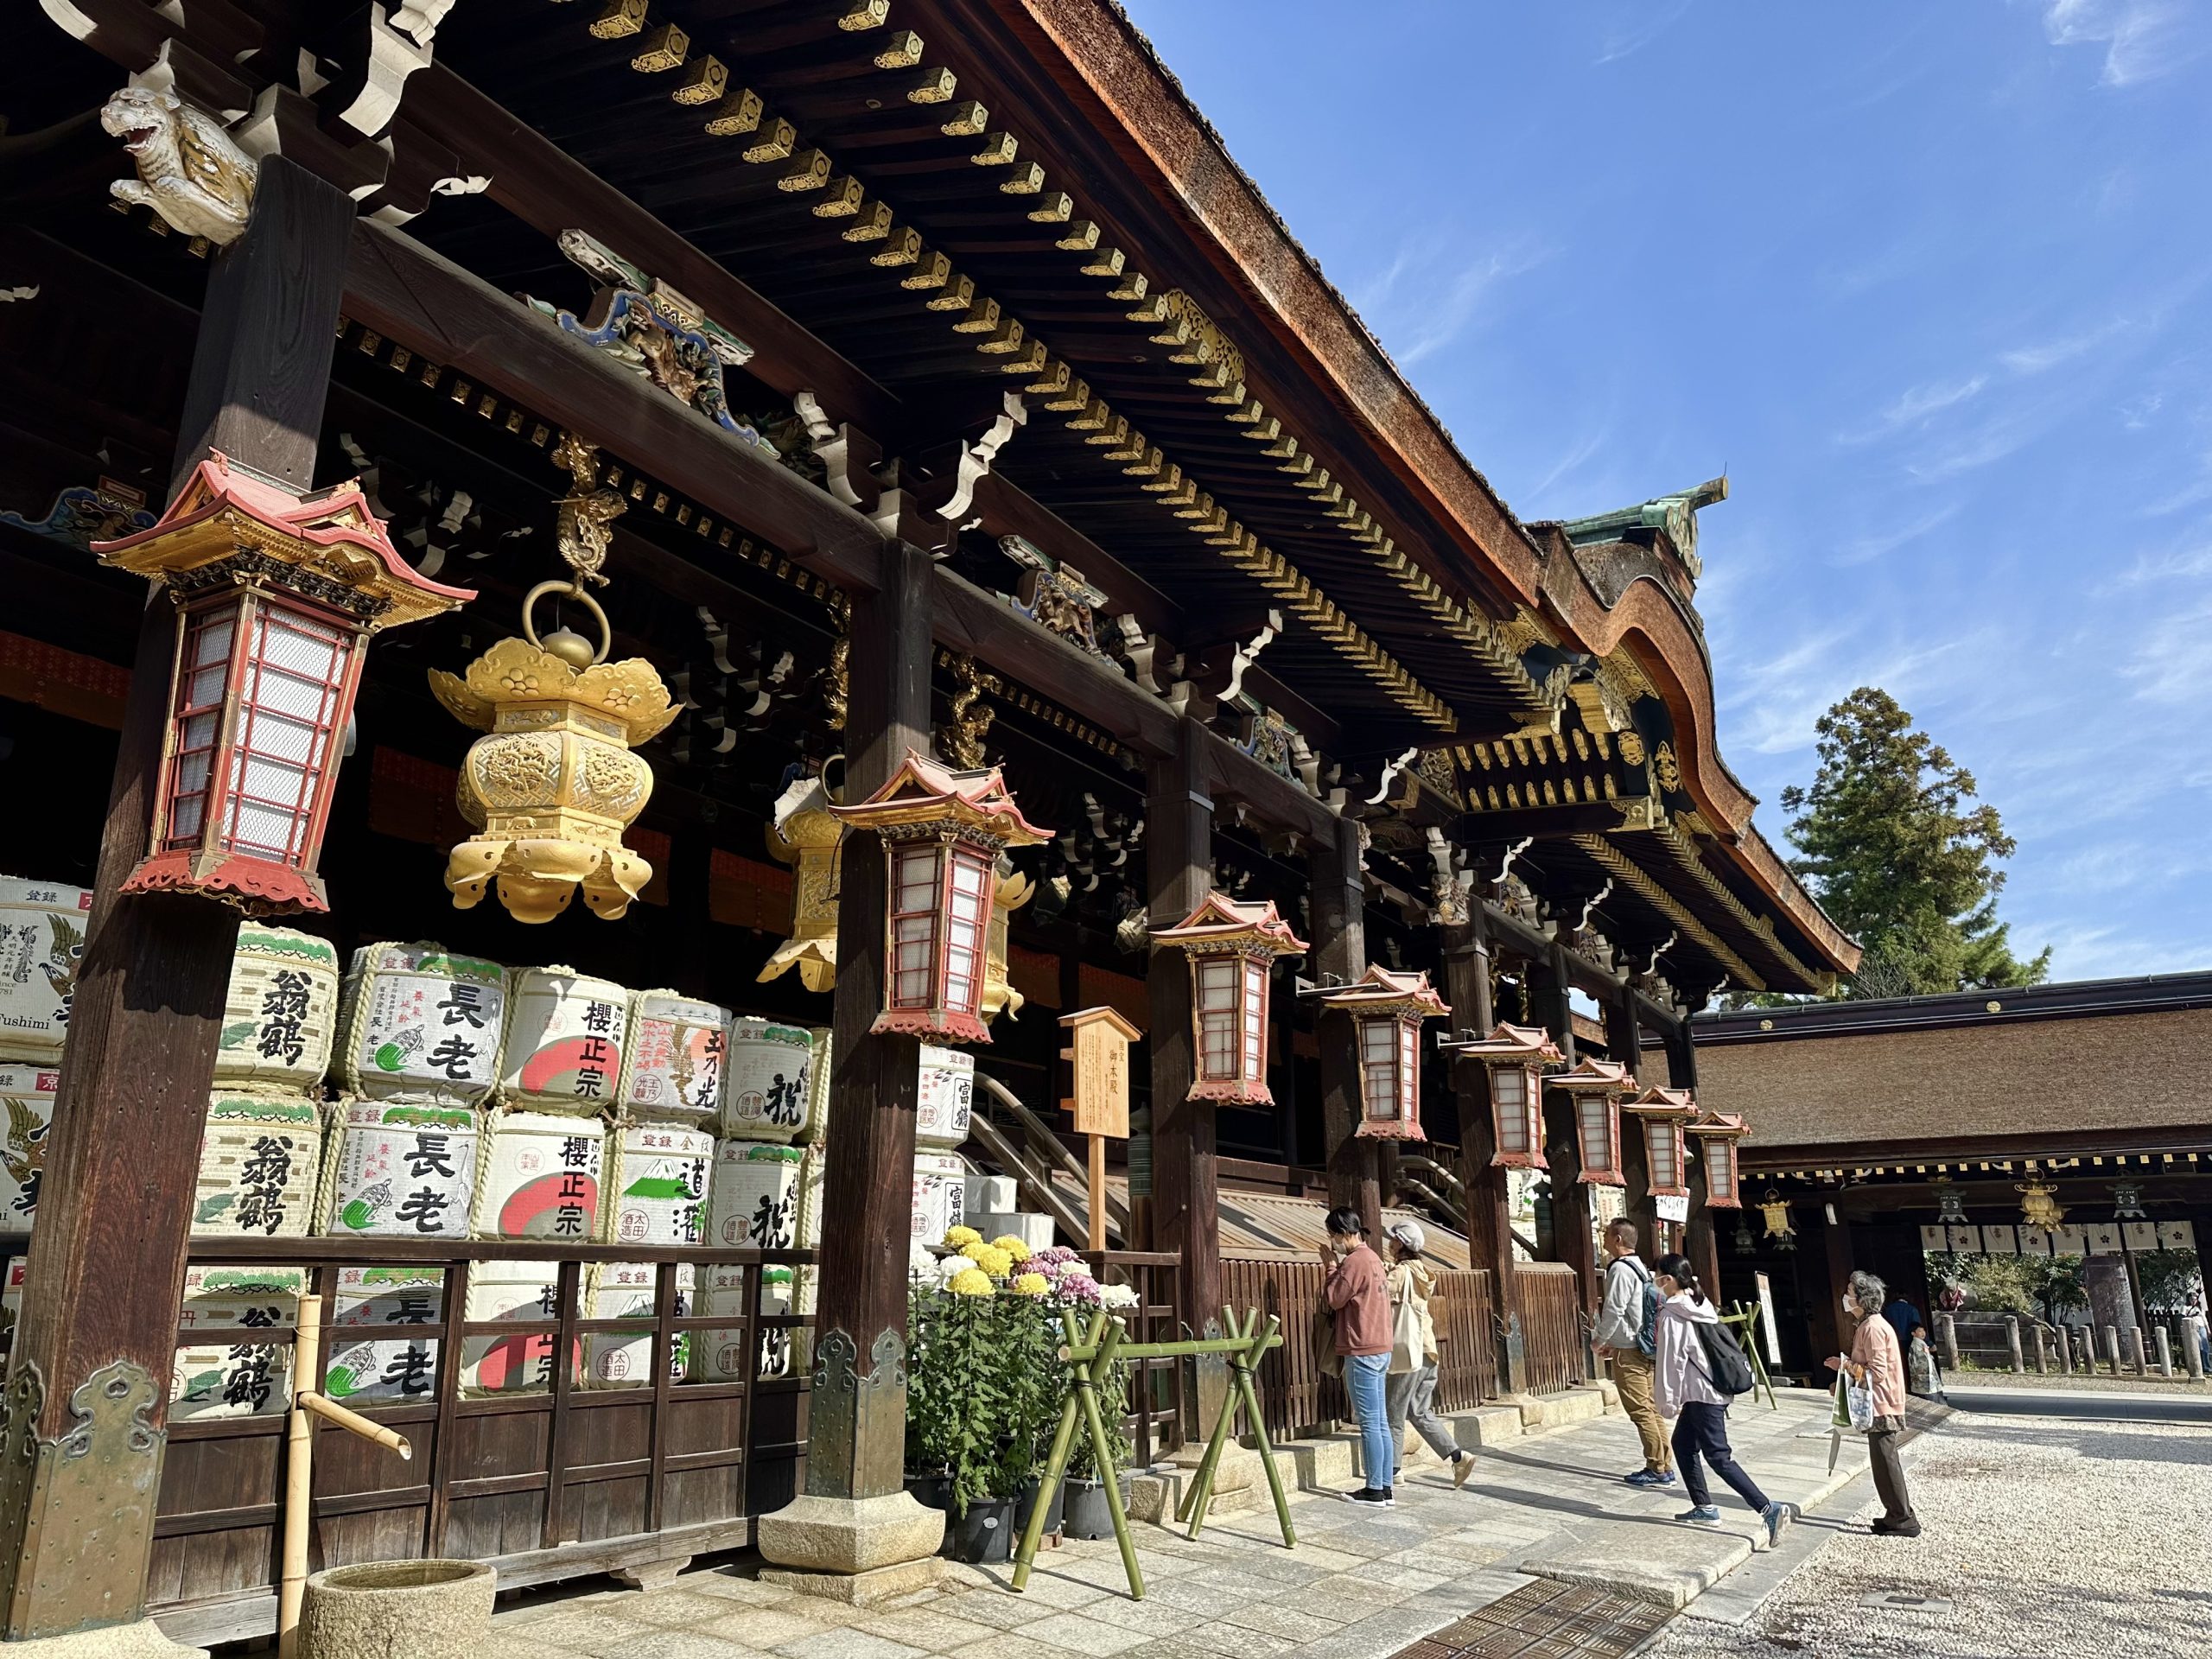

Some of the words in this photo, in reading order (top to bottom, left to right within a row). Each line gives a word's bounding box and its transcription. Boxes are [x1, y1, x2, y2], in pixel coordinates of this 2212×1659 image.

[257, 969, 312, 1066] 翁鶴
[426, 982, 485, 1079] 長老
[574, 1000, 612, 1097] 櫻正宗
[696, 1030, 725, 1108] 玉乃光
[347, 1109, 380, 1123] 登録
[641, 1135, 672, 1148] 登録
[235, 1135, 293, 1236] 翁鶴
[395, 1133, 455, 1232] 長老
[555, 1136, 588, 1236] 櫻正宗
[186, 1273, 203, 1287] 録
[344, 1270, 361, 1284] 録
[616, 1271, 648, 1284] 登録
